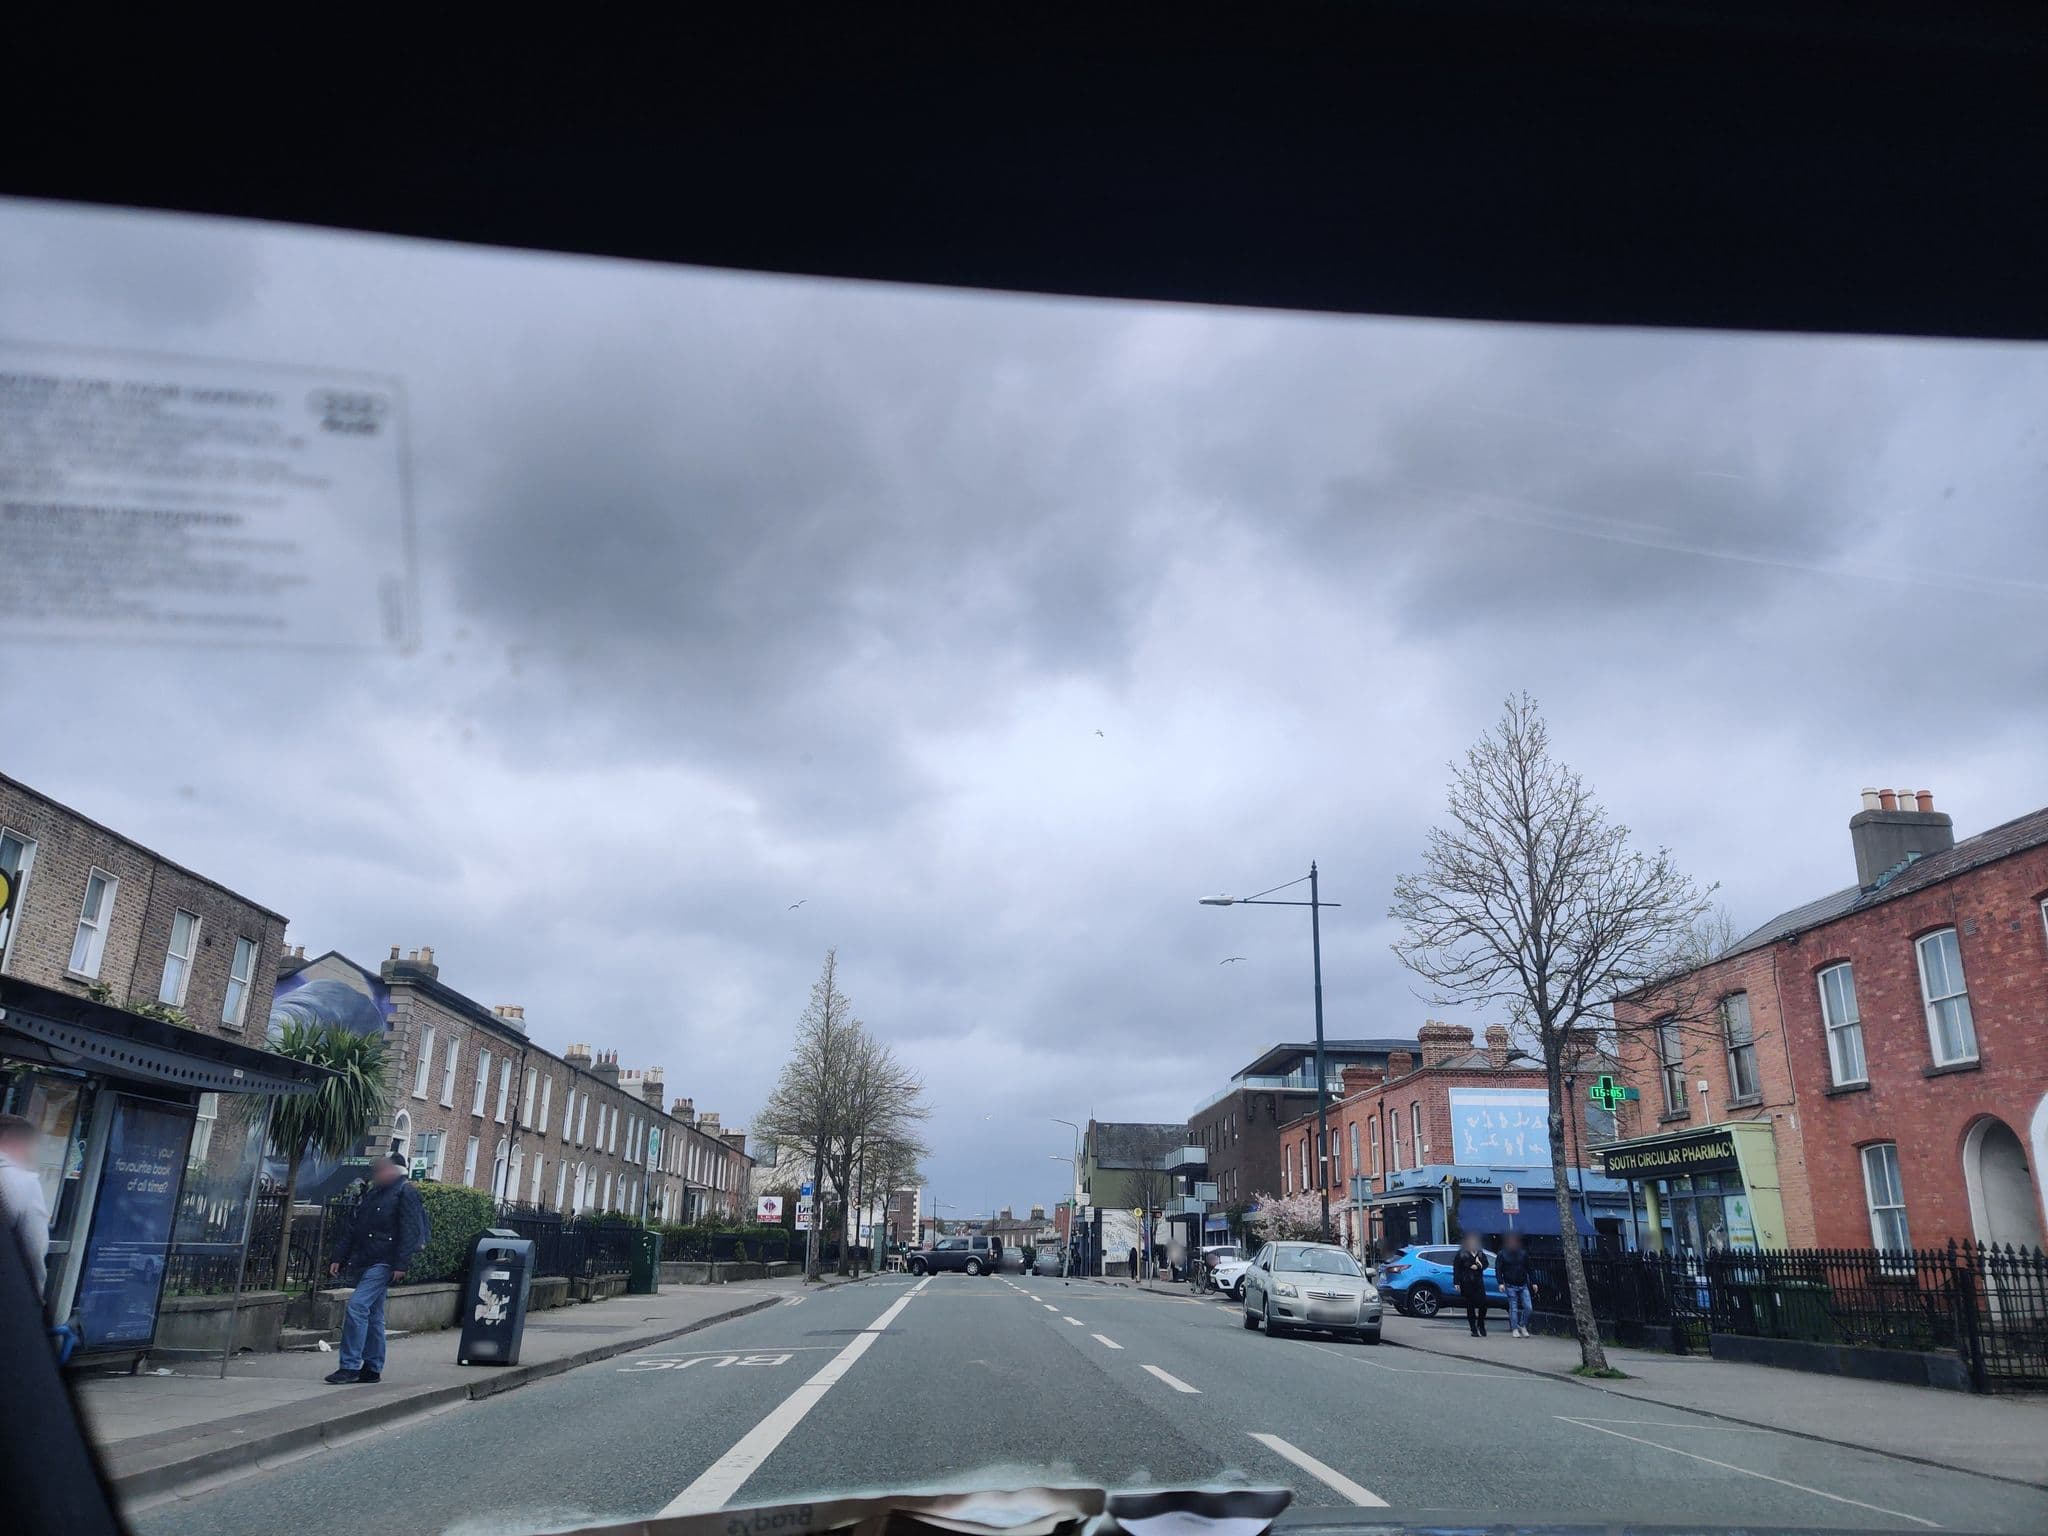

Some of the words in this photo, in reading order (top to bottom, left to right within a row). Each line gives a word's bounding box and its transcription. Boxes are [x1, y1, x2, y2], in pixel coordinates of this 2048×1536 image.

[1609, 1157, 1637, 1171] SOUTH
[1637, 1148, 1682, 1168] CIRCULAR
[1682, 1140, 1736, 1163] PHARMACY
[115, 1158, 152, 1174] favourite
[152, 1162, 172, 1175] book
[127, 1178, 138, 1191] of
[137, 1179, 147, 1192] all
[147, 1180, 169, 1193] time?
[616, 1353, 794, 1372] BUS
